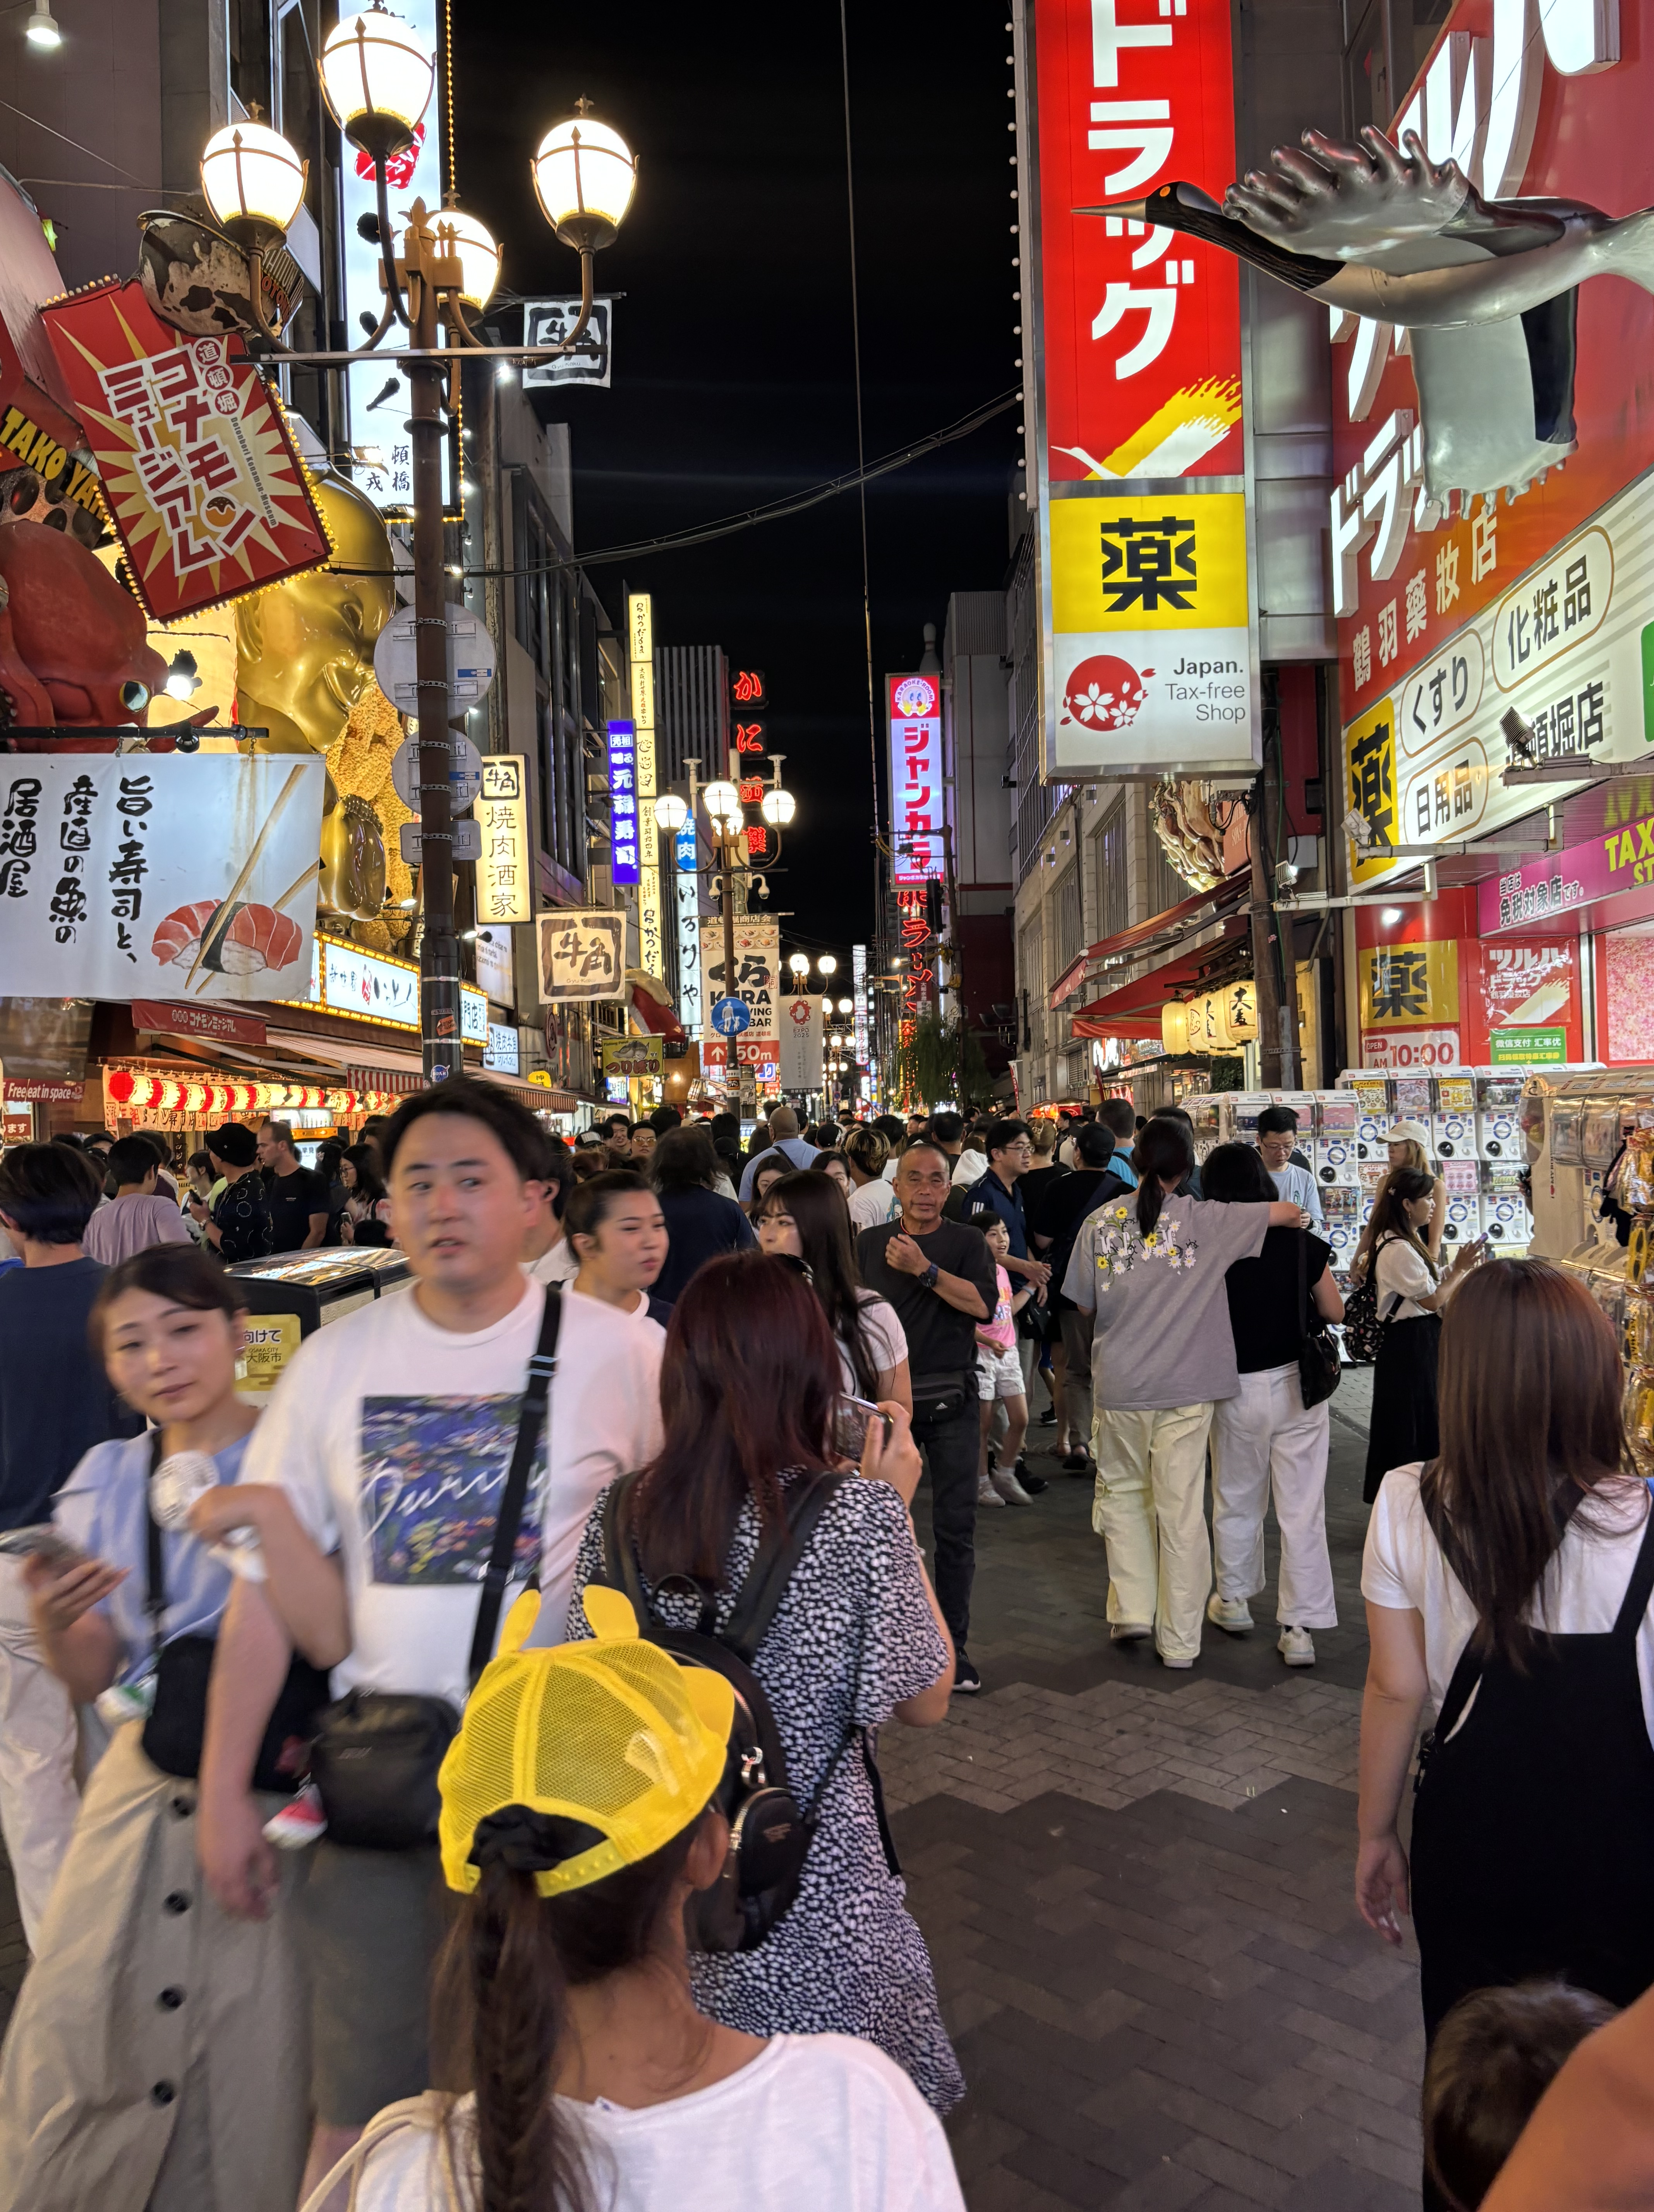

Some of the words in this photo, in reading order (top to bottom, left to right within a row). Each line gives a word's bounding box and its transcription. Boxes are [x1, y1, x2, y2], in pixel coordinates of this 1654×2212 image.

[197, 342, 239, 413] 道頓堀
[0, 409, 67, 481] TAKO
[102, 364, 219, 572] ミュージアム
[152, 351, 259, 549] コナモン
[231, 417, 251, 456] Dotonbori
[246, 457, 277, 527] Konamon-Museum
[1100, 516, 1197, 613] 薬
[1352, 502, 1497, 692] 鶴羽藥妝店
[1507, 554, 1591, 670] 化粧品
[897, 680, 920, 701] KARAOKE
[921, 683, 933, 700] ROOM
[1165, 682, 1245, 701] Tax-free
[1173, 658, 1244, 678] Japan.
[1412, 655, 1469, 735] くすり
[612, 736, 631, 747] 元祖
[1196, 704, 1246, 723] Shop
[1506, 682, 1604, 766] 頓堀店
[485, 768, 516, 792] 牛角
[903, 723, 932, 871] ジャンカラ
[1350, 723, 1393, 868] 薬
[1416, 759, 1472, 837] 日用品
[0, 778, 43, 898] 居酒屋
[613, 768, 636, 866] 元禄寿司
[1604, 817, 1654, 872] TAX
[48, 775, 99, 945] 産直の魚の
[108, 775, 154, 963] 旨い寿司と、
[486, 805, 519, 917] 焼肉酒家
[1499, 871, 1522, 895] 当店は
[1499, 874, 1584, 928] 免税対象店です。
[553, 931, 613, 976] 牛角
[678, 885, 698, 1008] いろりや
[708, 954, 771, 988] くら
[1371, 951, 1429, 1019] 薬
[605, 1059, 660, 1075] つりぼり
[726, 1044, 772, 1061] 50m
[1366, 1042, 1383, 1050] OPEN
[1374, 1058, 1388, 1068] AM
[1390, 1042, 1454, 1067] 10:00
[1495, 1039, 1530, 1048] 微信支付
[1534, 1037, 1561, 1047] 汇率优
[8, 1083, 27, 1098] Free
[27, 1085, 41, 1098] eat
[41, 1083, 49, 1099] in
[50, 1088, 71, 1102] space
[242, 1329, 282, 1344] 向けて
[246, 1353, 282, 1364] 大阪市
